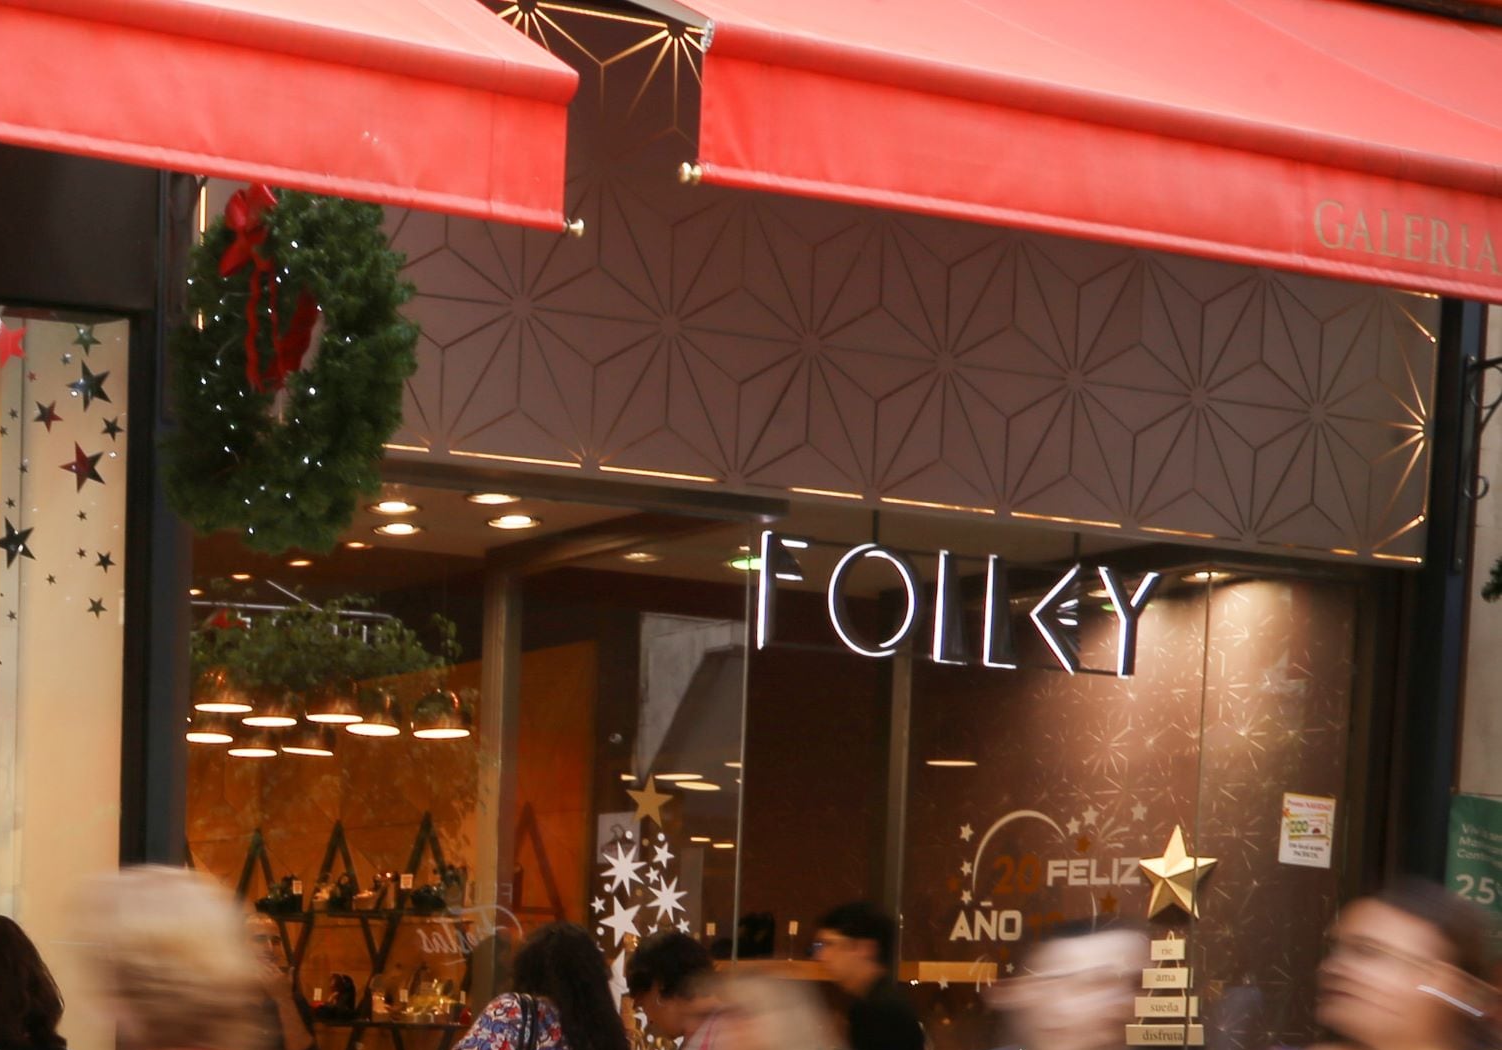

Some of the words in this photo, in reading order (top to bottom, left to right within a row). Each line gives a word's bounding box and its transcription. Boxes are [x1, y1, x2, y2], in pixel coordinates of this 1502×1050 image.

[756, 530, 1161, 680] FOLLEY
[993, 854, 1041, 894] 20
[1047, 857, 1141, 886] FELIZ
[949, 901, 1023, 942] AÑO
[1155, 974, 1177, 982] ama
[1142, 1029, 1184, 1041] disfruta
